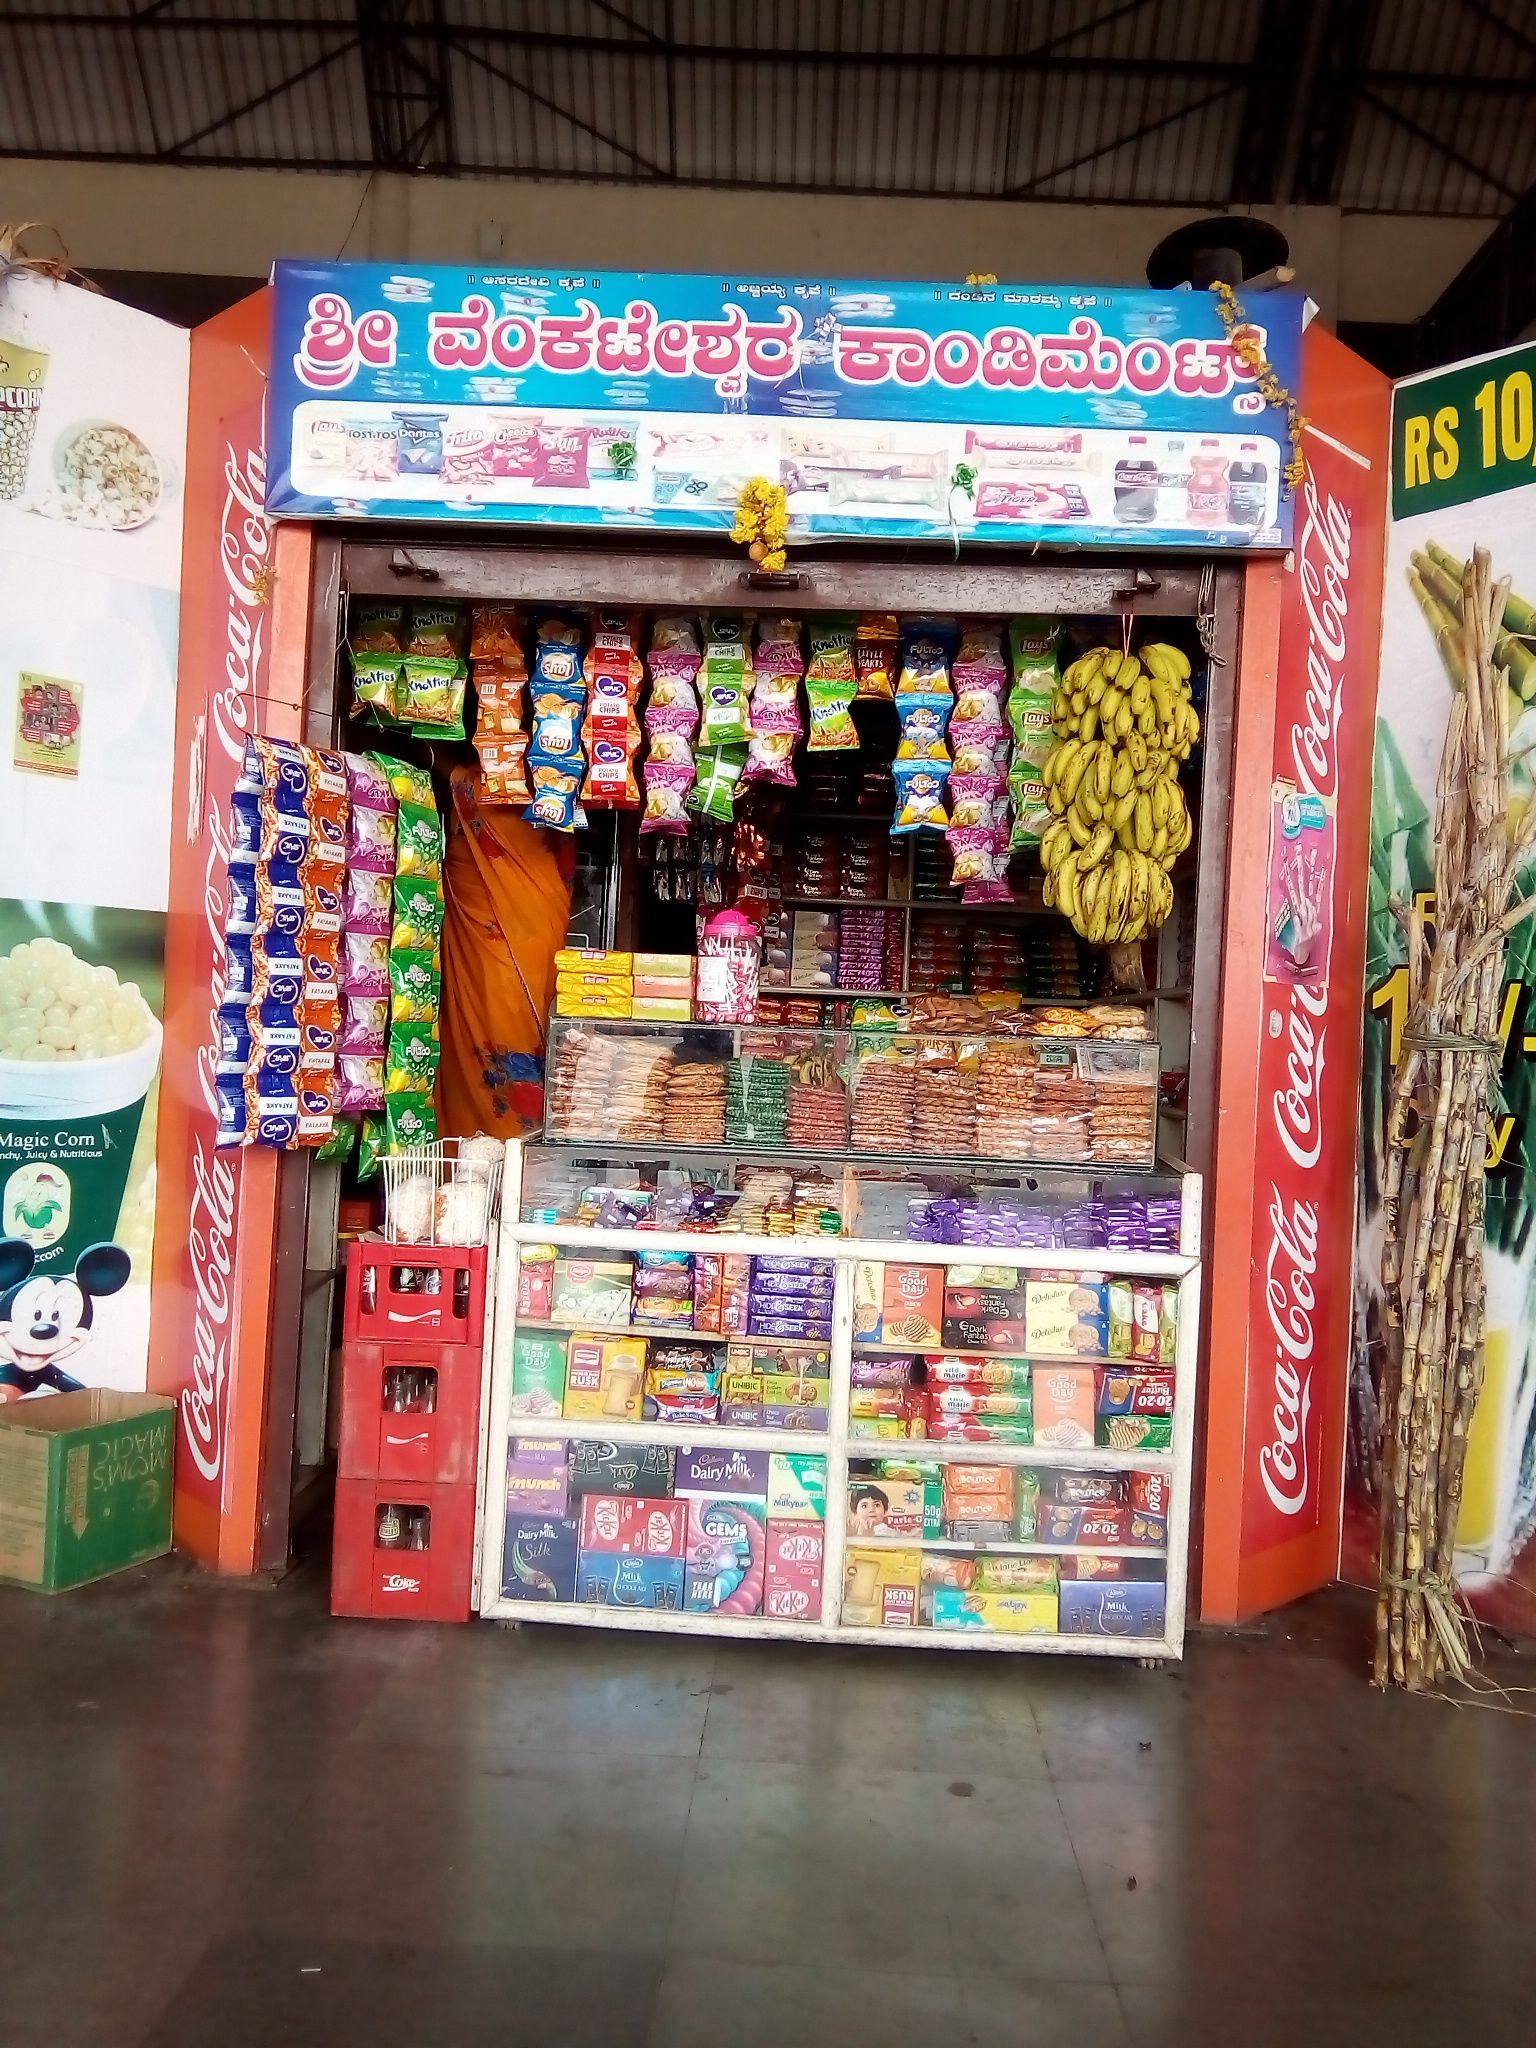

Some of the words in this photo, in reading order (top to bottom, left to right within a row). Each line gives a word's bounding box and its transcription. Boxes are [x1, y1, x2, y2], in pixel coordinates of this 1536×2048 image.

[295, 293, 398, 389] ಶ್ರೀ
[429, 295, 802, 397] ವೆಂಕಟೇಶ್ವರ
[1405, 406, 1460, 489] RS
[1474, 371, 1536, 469] 10
[0, 1131, 49, 1151] Magic
[54, 1131, 95, 1147] Corn
[25, 1150, 48, 1160] Juicy
[50, 1149, 57, 1158] &
[60, 1149, 103, 1158] Nutritious
[898, 1272, 928, 1287] Good
[902, 1283, 924, 1295] Day
[182, 1131, 236, 1481] Coca-Cola
[963, 1331, 992, 1341] Fantasy
[969, 1325, 988, 1334] Dark
[522, 1347, 550, 1360] Good
[1259, 1180, 1318, 1515] Coca-Cola
[525, 1356, 547, 1368] Day
[571, 1376, 599, 1386] RUSK
[732, 1381, 758, 1390] UNIBIC
[1048, 1377, 1077, 1390] Good
[1051, 1387, 1074, 1399] Day
[1141, 1386, 1170, 1395] Butter
[731, 1411, 758, 1421] UNIBIC
[97, 1424, 167, 1464] MAGIC
[690, 1464, 724, 1481] Dairy
[725, 1455, 752, 1480] Milk
[924, 1505, 941, 1518] 50g
[887, 1515, 923, 1525] Parle-G
[924, 1518, 941, 1528] EXTRA
[517, 1529, 539, 1540] Dairy
[539, 1526, 559, 1539] Milk
[705, 1522, 748, 1538] GEMS
[523, 1543, 552, 1561] Silk
[389, 1573, 420, 1588] Coke
[885, 1590, 914, 1600] RUSK
